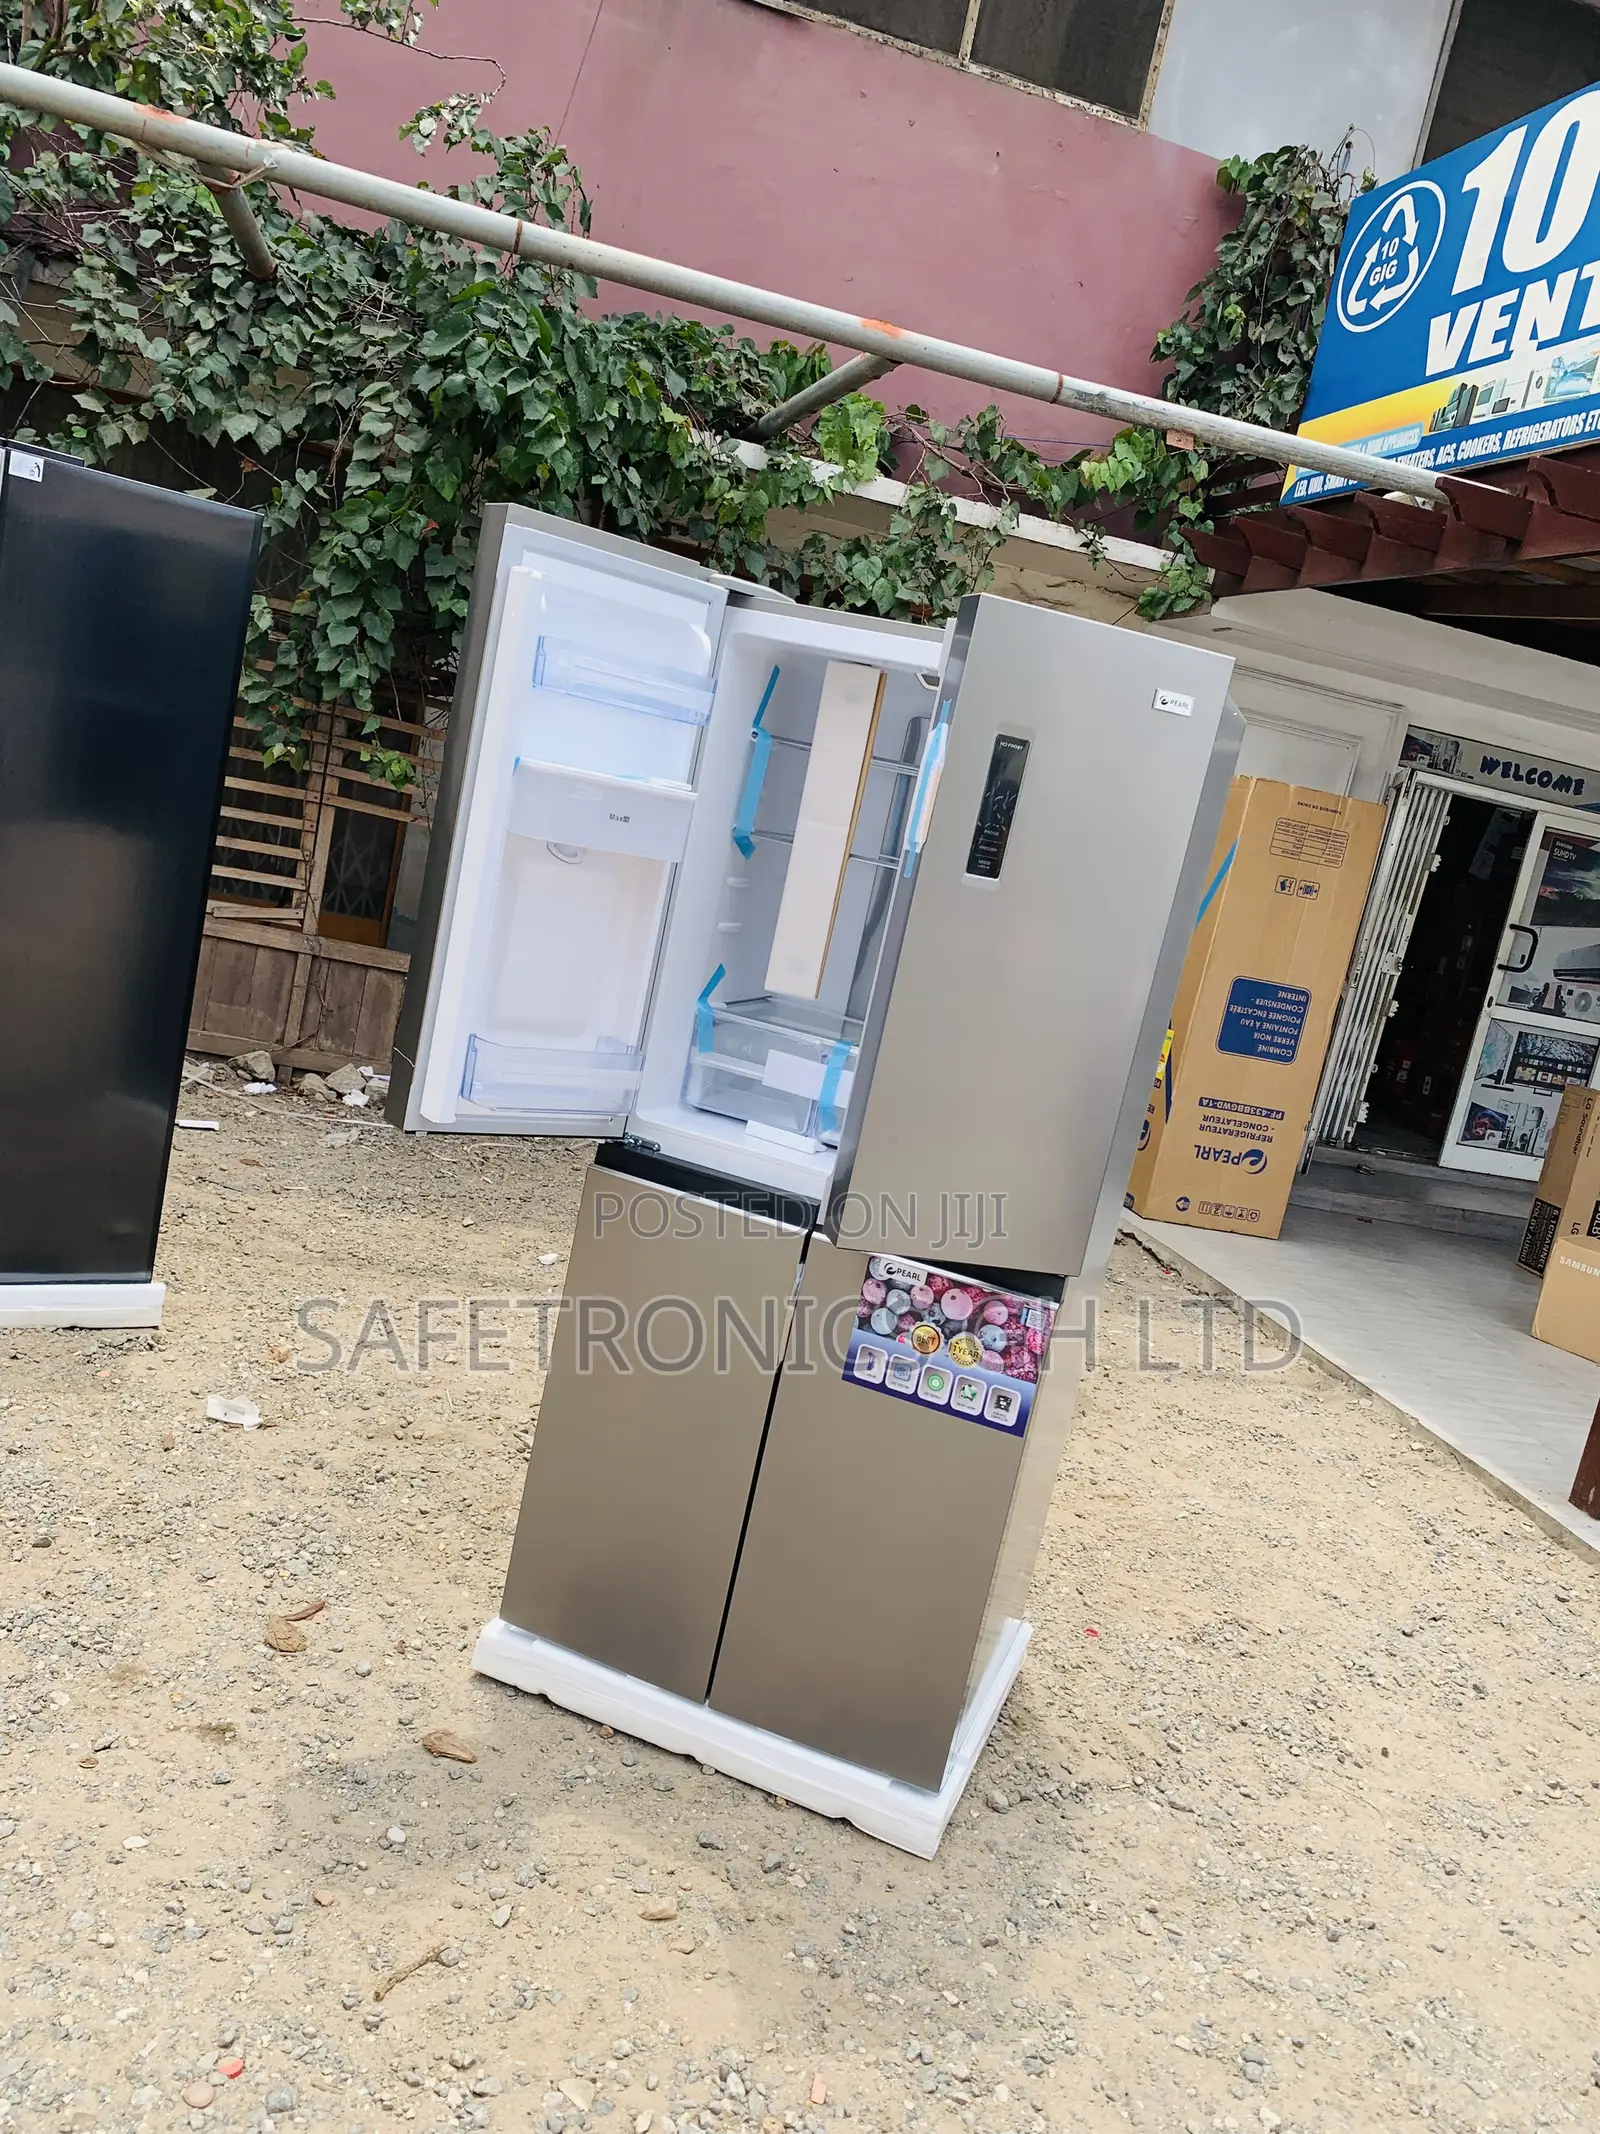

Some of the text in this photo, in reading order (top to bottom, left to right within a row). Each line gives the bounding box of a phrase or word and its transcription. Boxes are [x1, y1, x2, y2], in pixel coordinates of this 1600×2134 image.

[1451, 90, 1600, 296] 10
[1381, 237, 1399, 260] 10
[1369, 259, 1398, 287] GIG
[1435, 443, 1456, 465] ACS,
[1457, 432, 1502, 460] COOKERS,
[1502, 412, 1585, 450] REFRIGERATORS
[1480, 755, 1586, 796] WELCOME
[1277, 990, 1307, 1002] INTERNE
[1229, 1004, 1267, 1017] ENCASTRÉE
[1240, 1018, 1254, 1026] EAU
[1262, 1022, 1298, 1035] FONTAINE
[1254, 1032, 1295, 1046] VERRE NOIR
[1257, 1044, 1293, 1057] COMBINÉ
[1572, 1097, 1593, 1155] LG Soundbar
[1194, 1144, 1242, 1166] PEARL
[1529, 1202, 1541, 1231] DOLBY
[1571, 1222, 1581, 1235] LG
[1520, 1232, 1532, 1262] AUDIO
[896, 1268, 921, 1281] PEARL
[916, 1333, 936, 1346] BEST
